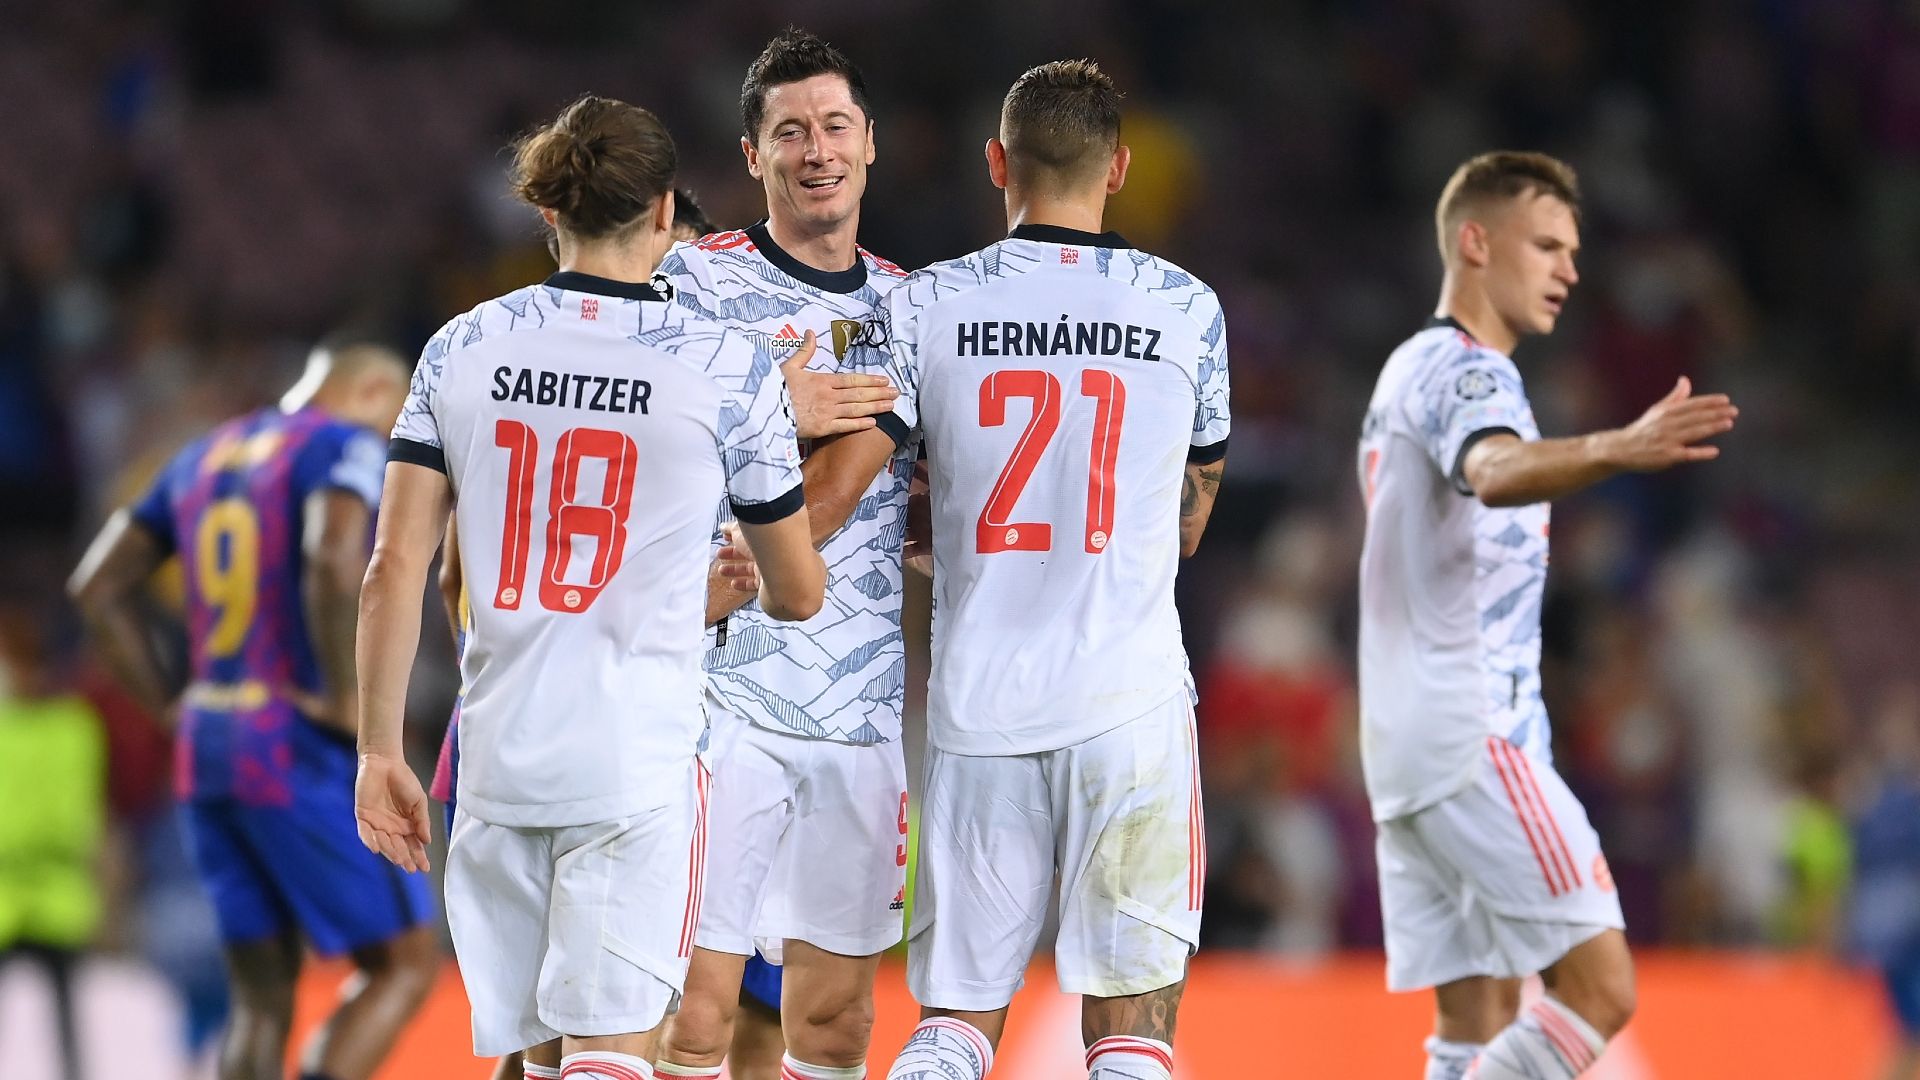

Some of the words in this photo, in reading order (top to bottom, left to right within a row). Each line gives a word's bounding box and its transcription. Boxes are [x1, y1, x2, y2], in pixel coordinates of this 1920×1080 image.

[491, 366, 652, 415] SABITZER
[957, 314, 1162, 362] HERNÁNDEZ
[493, 418, 639, 614] 18
[976, 368, 1127, 554] 21
[196, 495, 260, 659] 9
